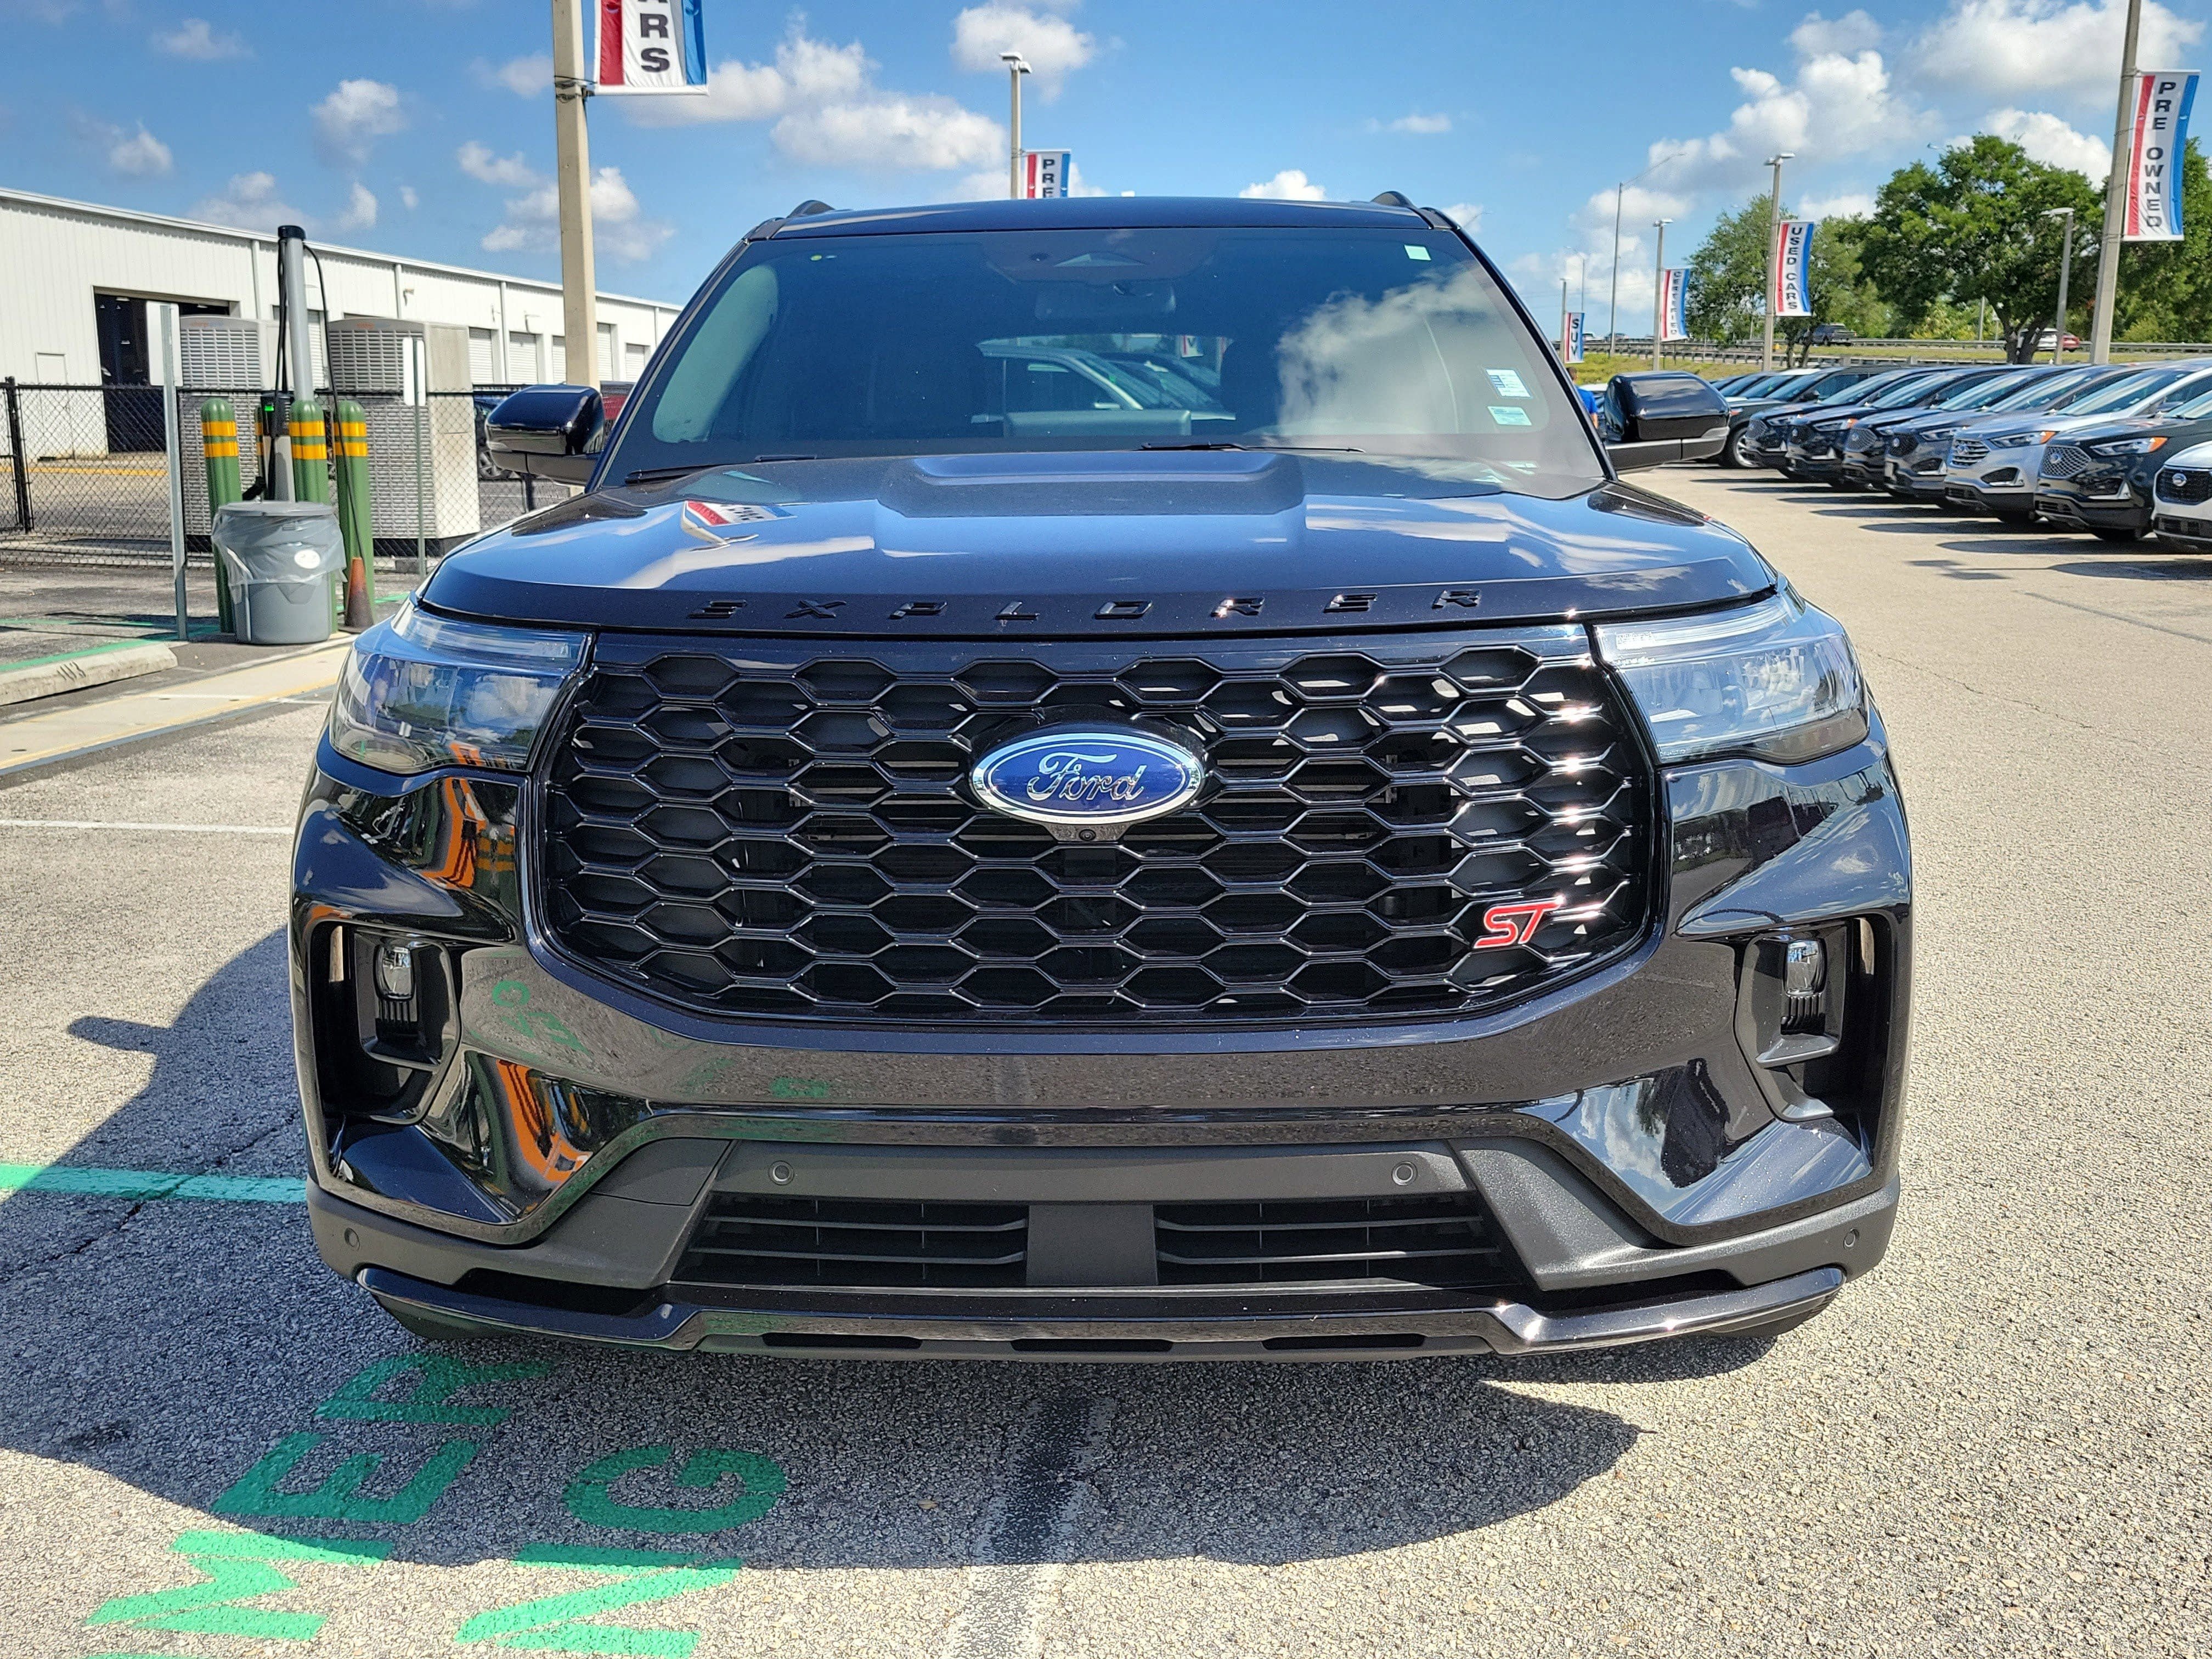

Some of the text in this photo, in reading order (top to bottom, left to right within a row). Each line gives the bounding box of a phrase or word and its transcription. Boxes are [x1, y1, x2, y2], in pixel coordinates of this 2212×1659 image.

[637, 0, 670, 72] RS
[2145, 82, 2176, 227] PRE OWNED
[1786, 227, 1803, 309] USED CARS
[1571, 318, 1579, 356] SUV
[689, 589, 1481, 620] EXPLORER
[1026, 752, 1144, 802] Ford
[1473, 896, 1562, 949] ST
